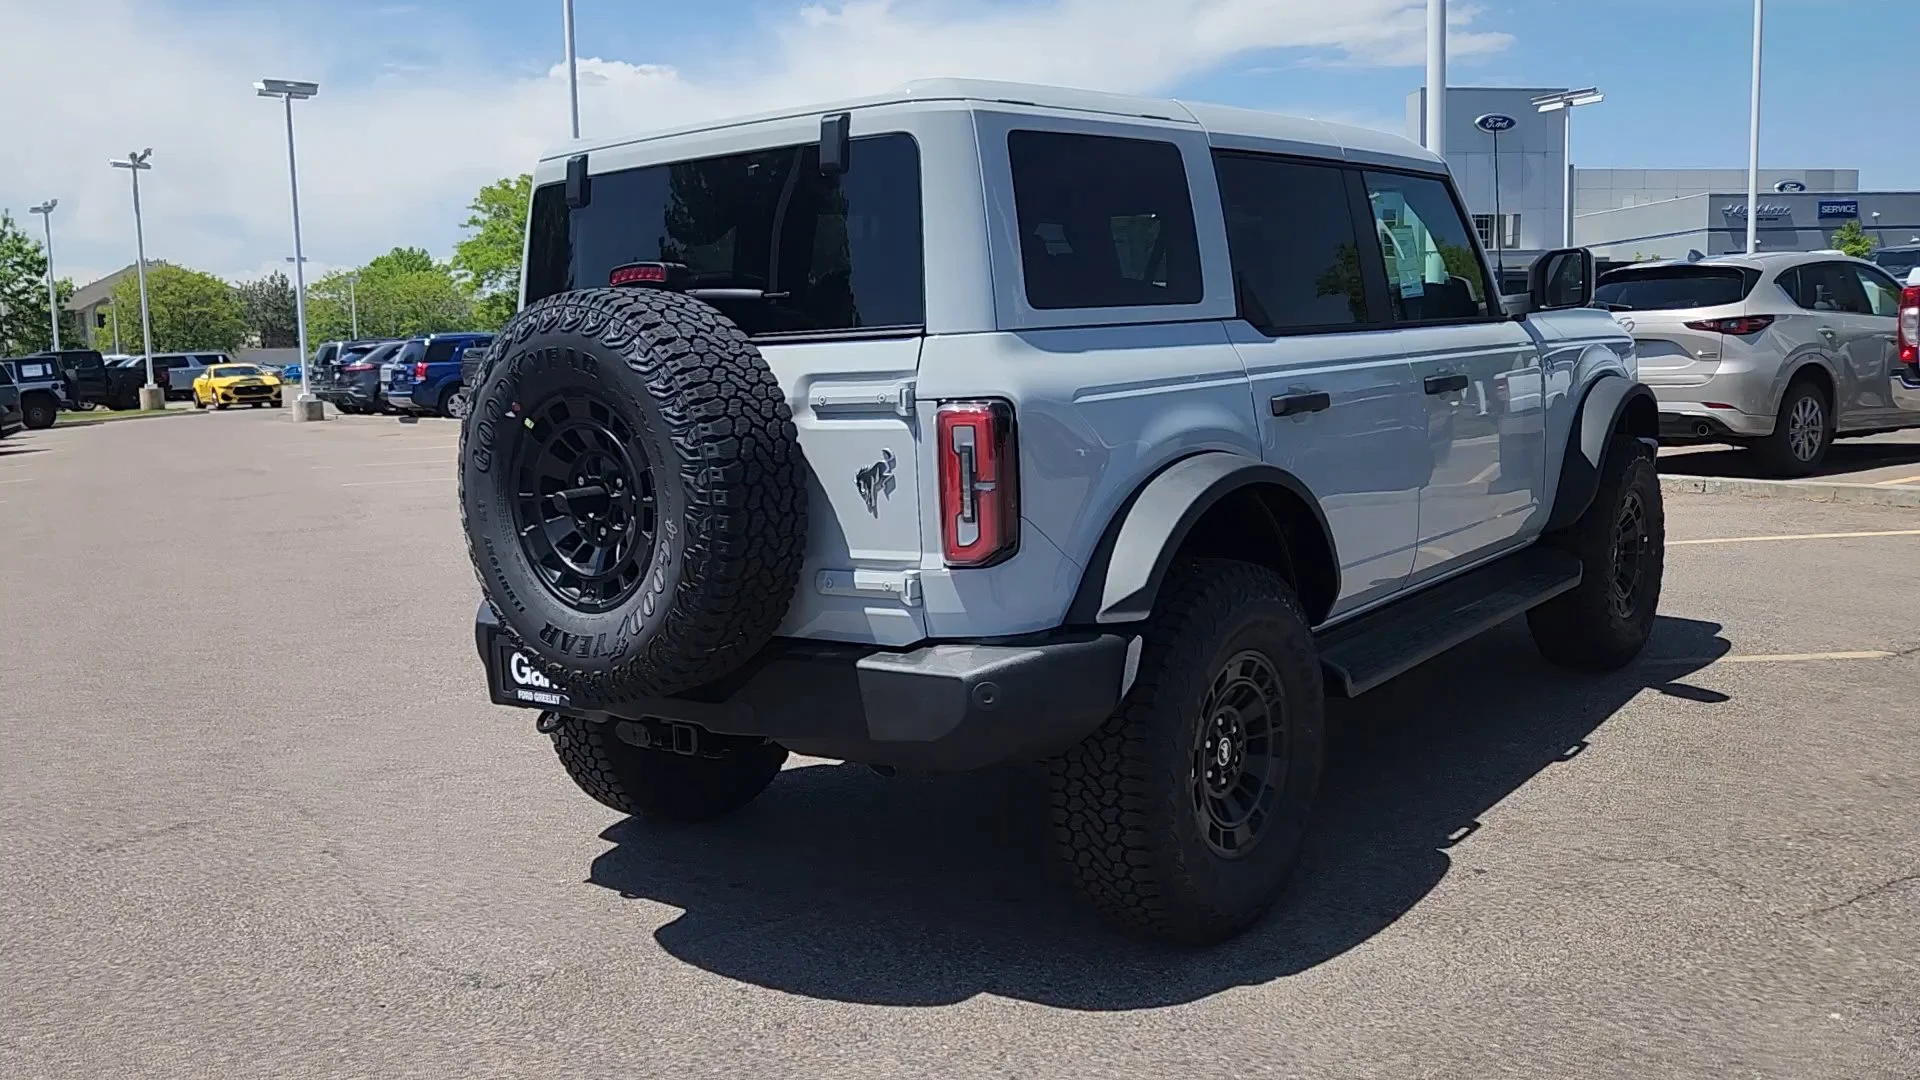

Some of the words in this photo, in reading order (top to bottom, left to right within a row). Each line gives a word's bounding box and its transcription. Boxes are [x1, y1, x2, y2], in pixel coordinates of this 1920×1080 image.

[1821, 204, 1857, 215] SERVICE
[517, 690, 533, 701] FORD
[533, 692, 561, 705] GREELEY
